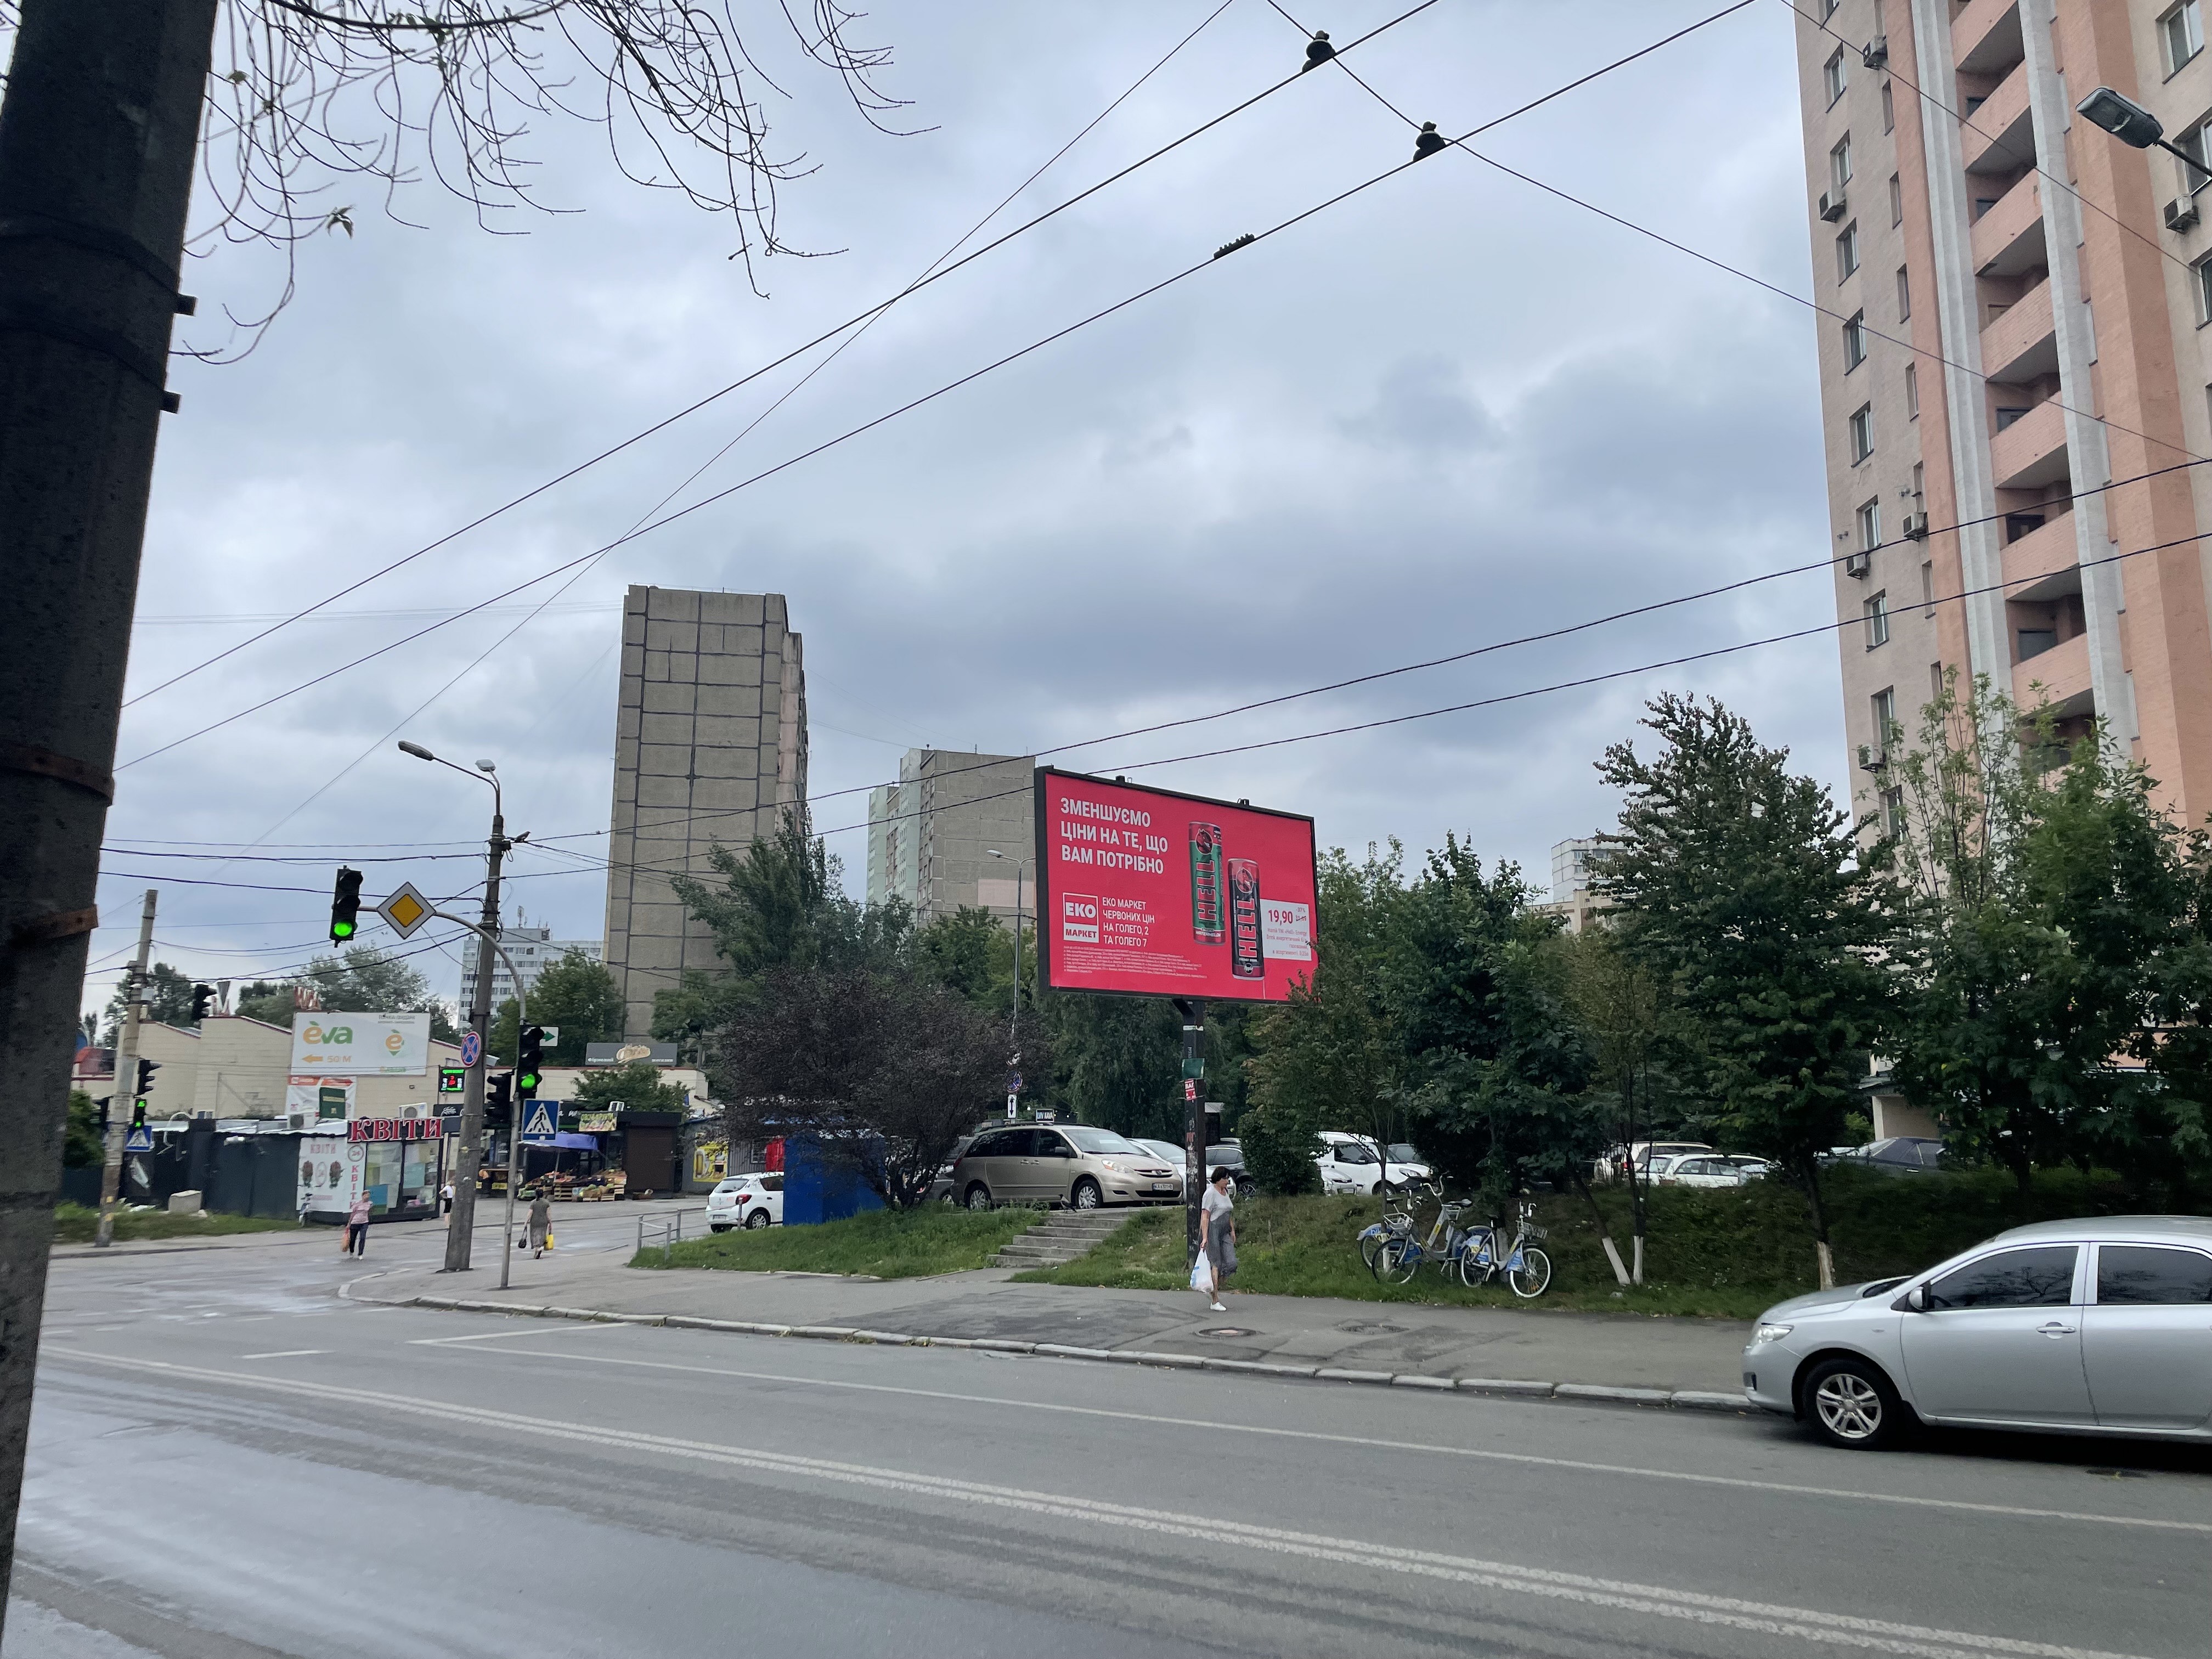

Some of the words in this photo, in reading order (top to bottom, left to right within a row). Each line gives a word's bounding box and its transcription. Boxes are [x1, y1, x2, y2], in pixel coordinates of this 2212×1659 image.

[1060, 797, 1151, 827] ЗМЕНШУЄМО
[1061, 821, 1097, 842] ЦІНИ
[1100, 827, 1120, 845] НА
[1122, 831, 1143, 852] ТЕ,
[1146, 834, 1168, 855] ЩО
[1062, 844, 1093, 865] ВАМ
[1097, 849, 1164, 874] ПОТРІБНО
[1196, 860, 1217, 921] HELL
[1065, 902, 1096, 918] ЕКО
[1102, 896, 1116, 907] ЕКО
[1118, 898, 1147, 910] МАРКЕТ
[1103, 910, 1141, 922] ЧЕРВОНИХ
[1142, 914, 1155, 925] ЦІН
[1268, 909, 1293, 926] 19,90
[1065, 929, 1097, 938] МАРКЕТ
[1103, 922, 1114, 932] НА
[1115, 923, 1143, 936] ГОЛЕГО,
[1144, 926, 1149, 935] 2
[1237, 898, 1257, 958] HELL
[1103, 935, 1113, 945] ТА
[1115, 936, 1142, 947] ГОЛЕГО
[1142, 938, 1147, 947] 7
[349, 1118, 444, 1142] КВІТИ
